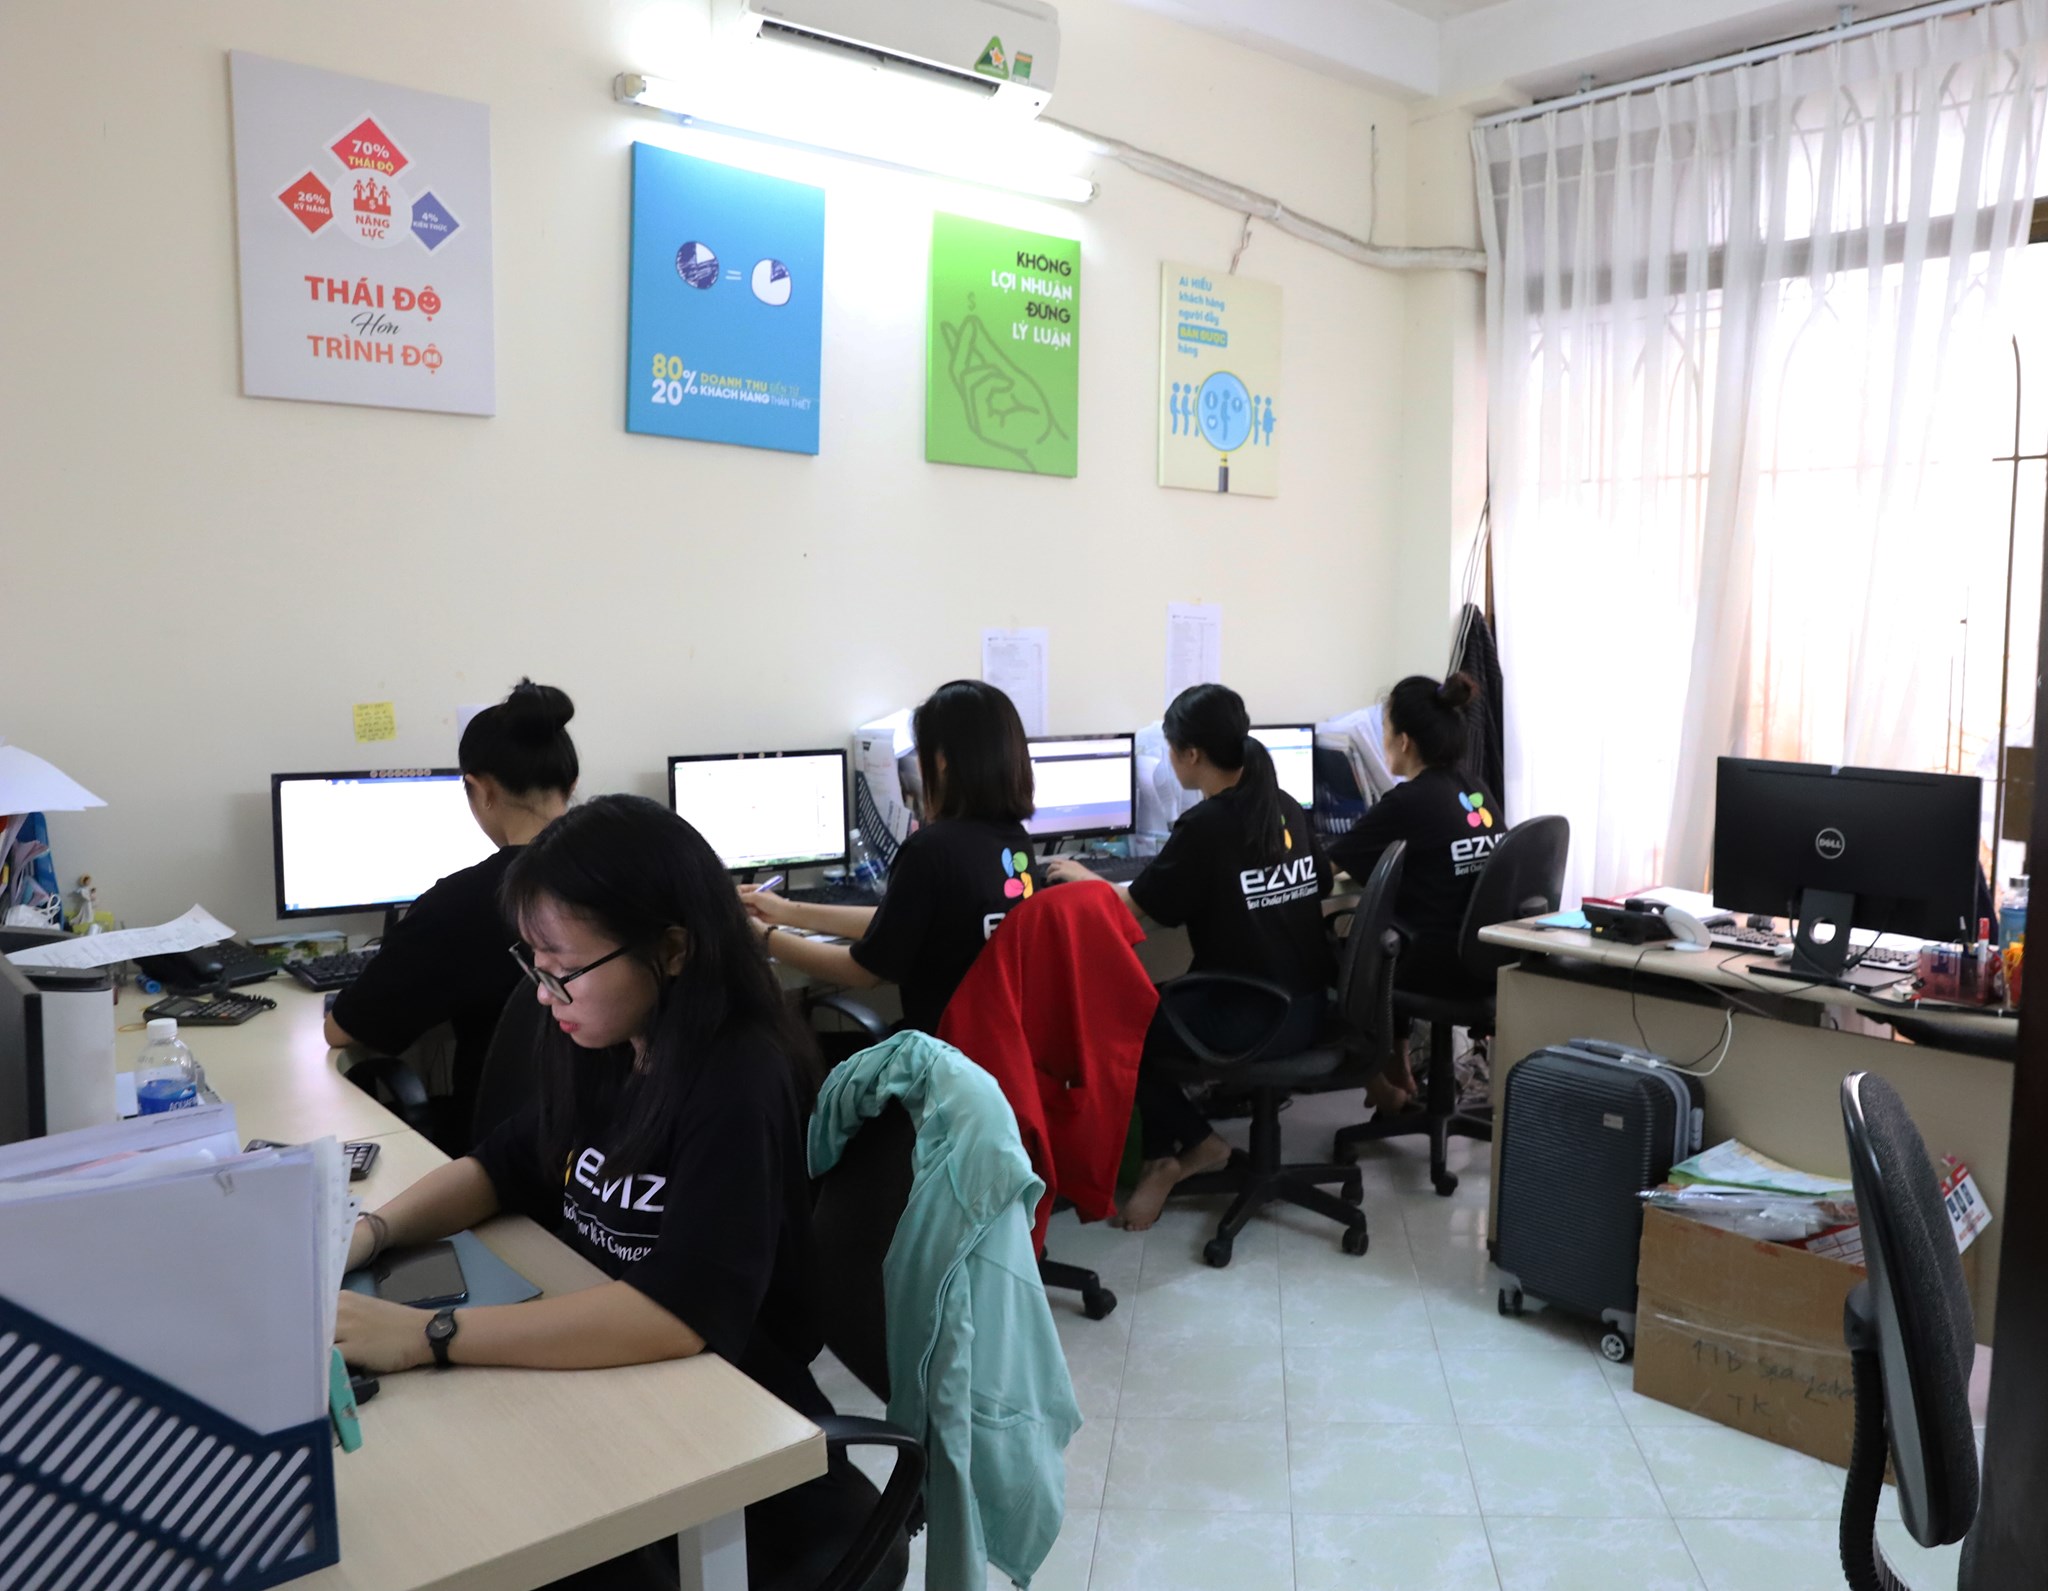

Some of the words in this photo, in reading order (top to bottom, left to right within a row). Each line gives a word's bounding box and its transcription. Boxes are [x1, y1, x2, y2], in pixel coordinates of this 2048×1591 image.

[351, 139, 390, 159] 70%
[348, 155, 375, 169] THÁI
[376, 160, 394, 175] ĐỘ
[297, 190, 326, 206] 26%
[355, 213, 391, 229] NĂNG
[421, 211, 439, 224] 4%
[361, 227, 385, 240] LỰC
[1016, 250, 1072, 277] KHÔNG
[991, 269, 1016, 294] LỢI
[1021, 276, 1073, 304] NHUẬN
[304, 275, 384, 309] THÁI
[392, 284, 442, 322] ĐỘ
[350, 311, 401, 336] Hơn
[1012, 319, 1029, 341] LÝ
[1033, 326, 1072, 351] LUẬN
[306, 333, 394, 365] TRÌNH
[401, 342, 443, 375] ĐỘ
[651, 353, 684, 380] 80
[700, 372, 743, 389] DOANH
[745, 378, 768, 392] THU
[1819, 838, 1842, 849] DELL
